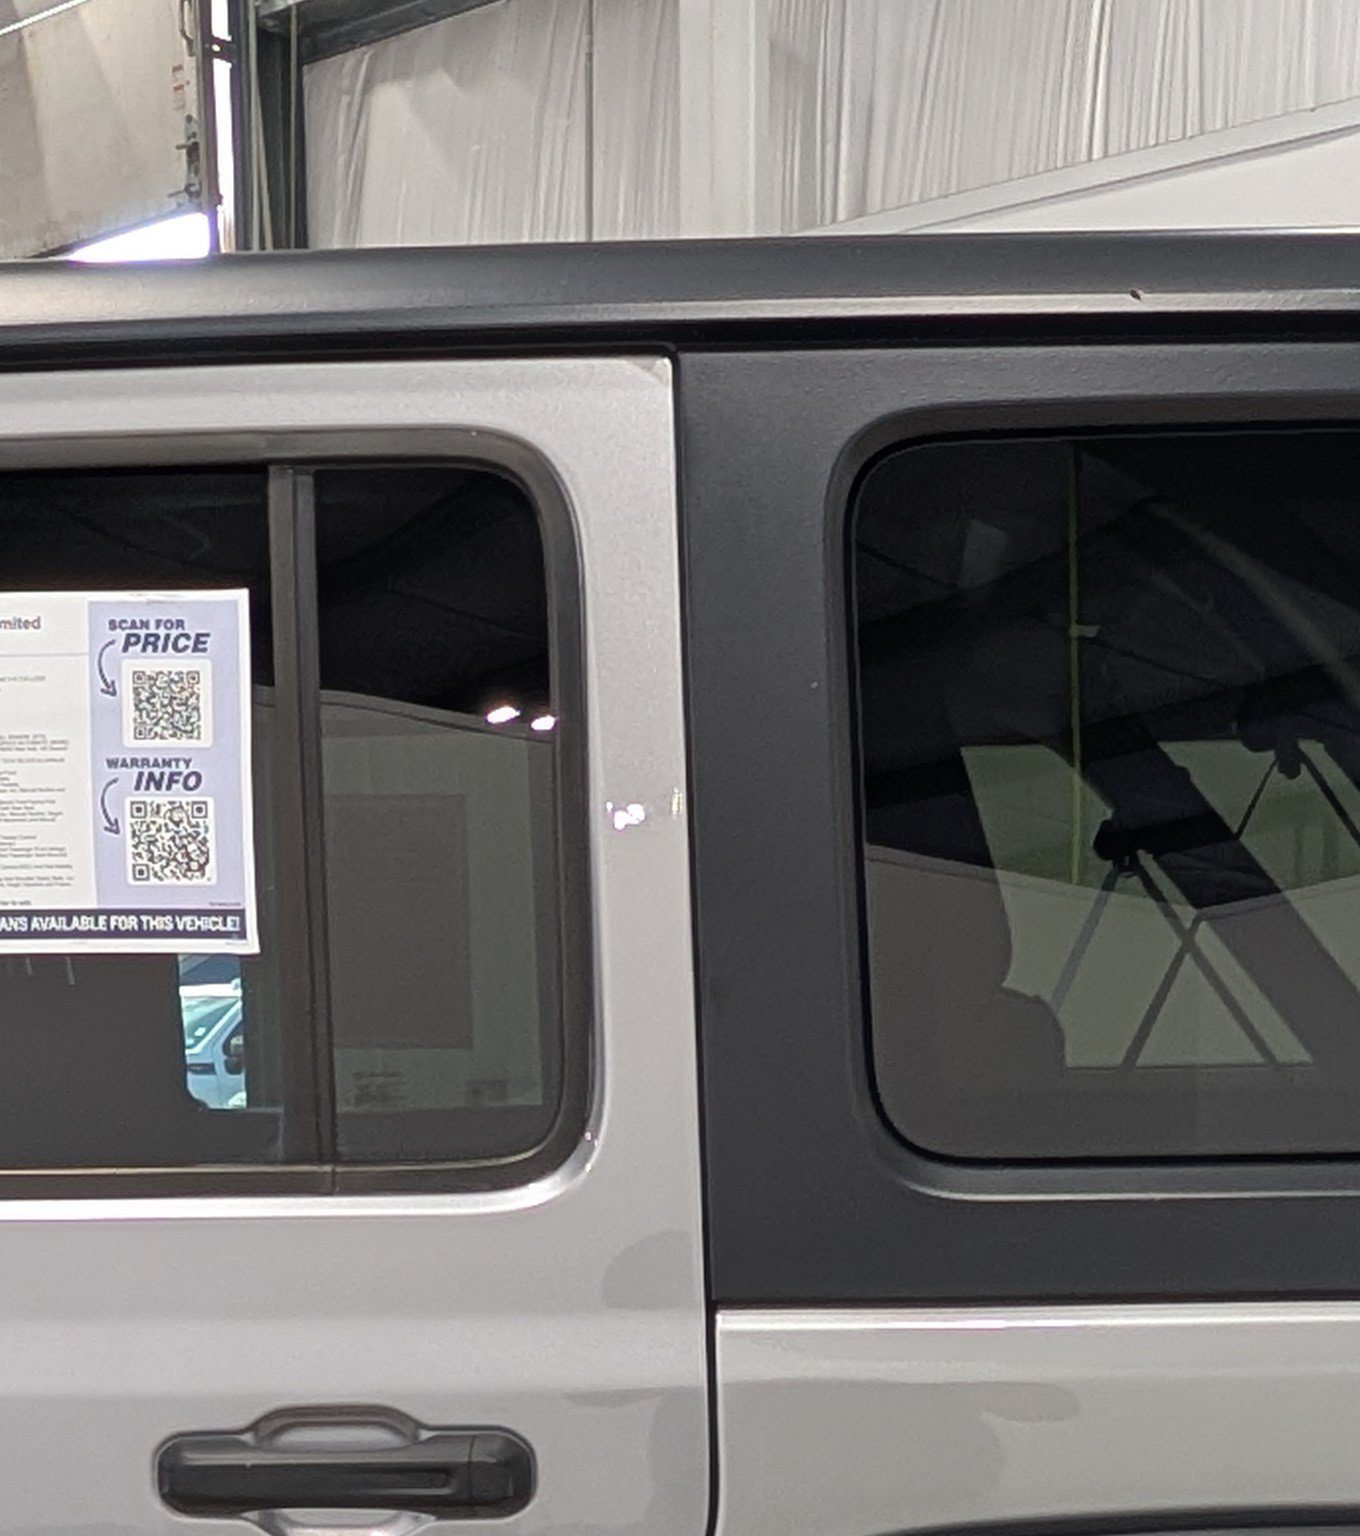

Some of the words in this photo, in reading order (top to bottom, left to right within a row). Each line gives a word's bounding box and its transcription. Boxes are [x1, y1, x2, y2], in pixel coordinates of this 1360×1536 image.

[108, 619, 150, 631] SCAN
[155, 618, 185, 631] FOR
[122, 632, 211, 654] PRICE
[106, 757, 193, 770] WARRANTY
[134, 771, 203, 792] INFO
[30, 914, 108, 931] AVAILABLE
[109, 914, 139, 931] FOR
[140, 914, 173, 931] THIS
[175, 914, 241, 931] VEHICLE!
